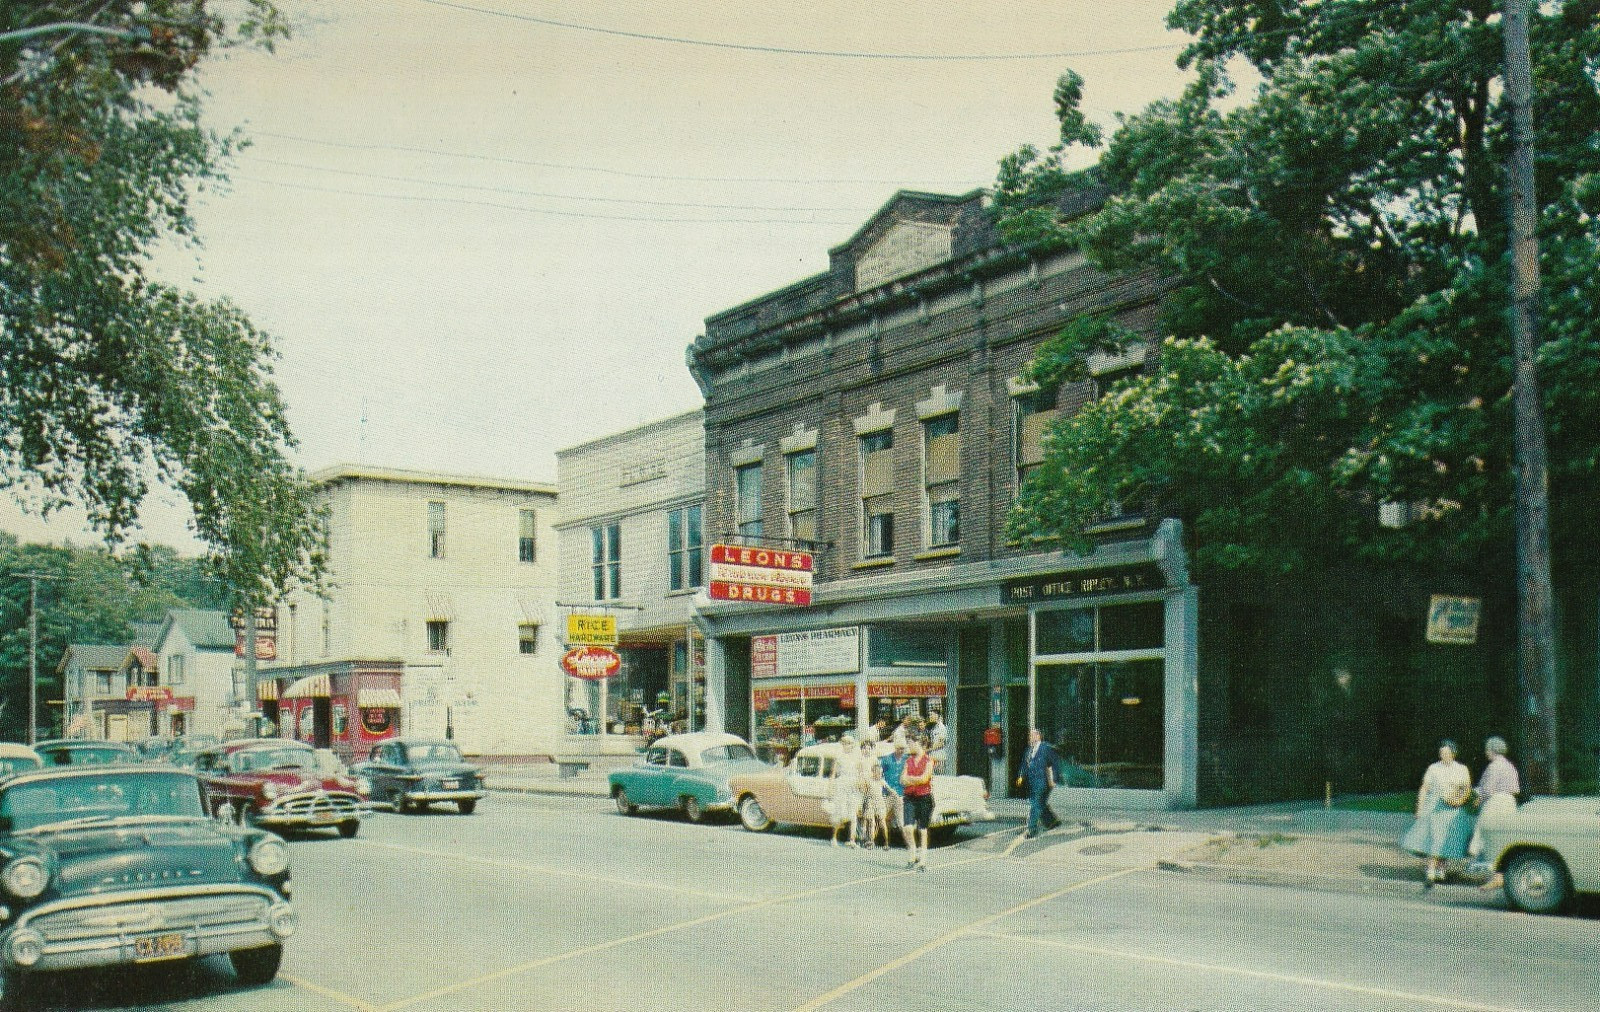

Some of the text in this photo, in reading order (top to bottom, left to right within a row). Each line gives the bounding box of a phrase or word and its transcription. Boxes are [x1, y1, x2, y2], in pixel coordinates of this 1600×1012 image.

[724, 549, 803, 568] LEONS
[728, 585, 796, 603] DRUGS
[1010, 585, 1034, 599] POST
[1042, 581, 1073, 596] OFFICE
[577, 619, 609, 631] RICE
[569, 633, 616, 643] HARDWARE
[810, 628, 857, 641] PHARMACY
